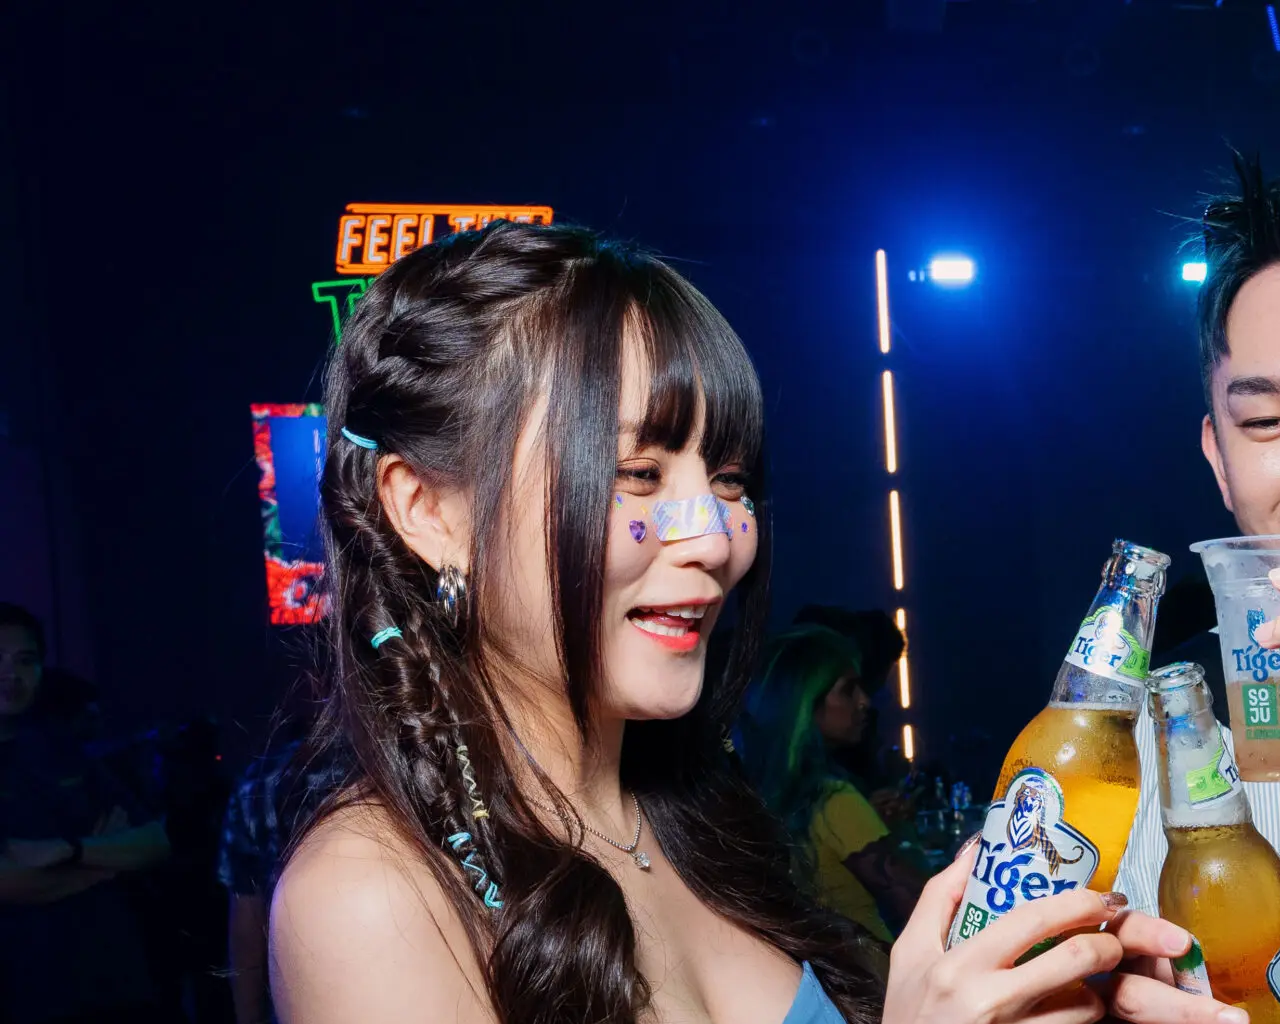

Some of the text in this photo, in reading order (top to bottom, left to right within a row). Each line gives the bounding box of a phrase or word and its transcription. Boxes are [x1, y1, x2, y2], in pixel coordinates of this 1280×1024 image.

[1248, 688, 1270, 706] SO
[1249, 707, 1271, 723] JU
[972, 838, 1078, 914] Tiger
